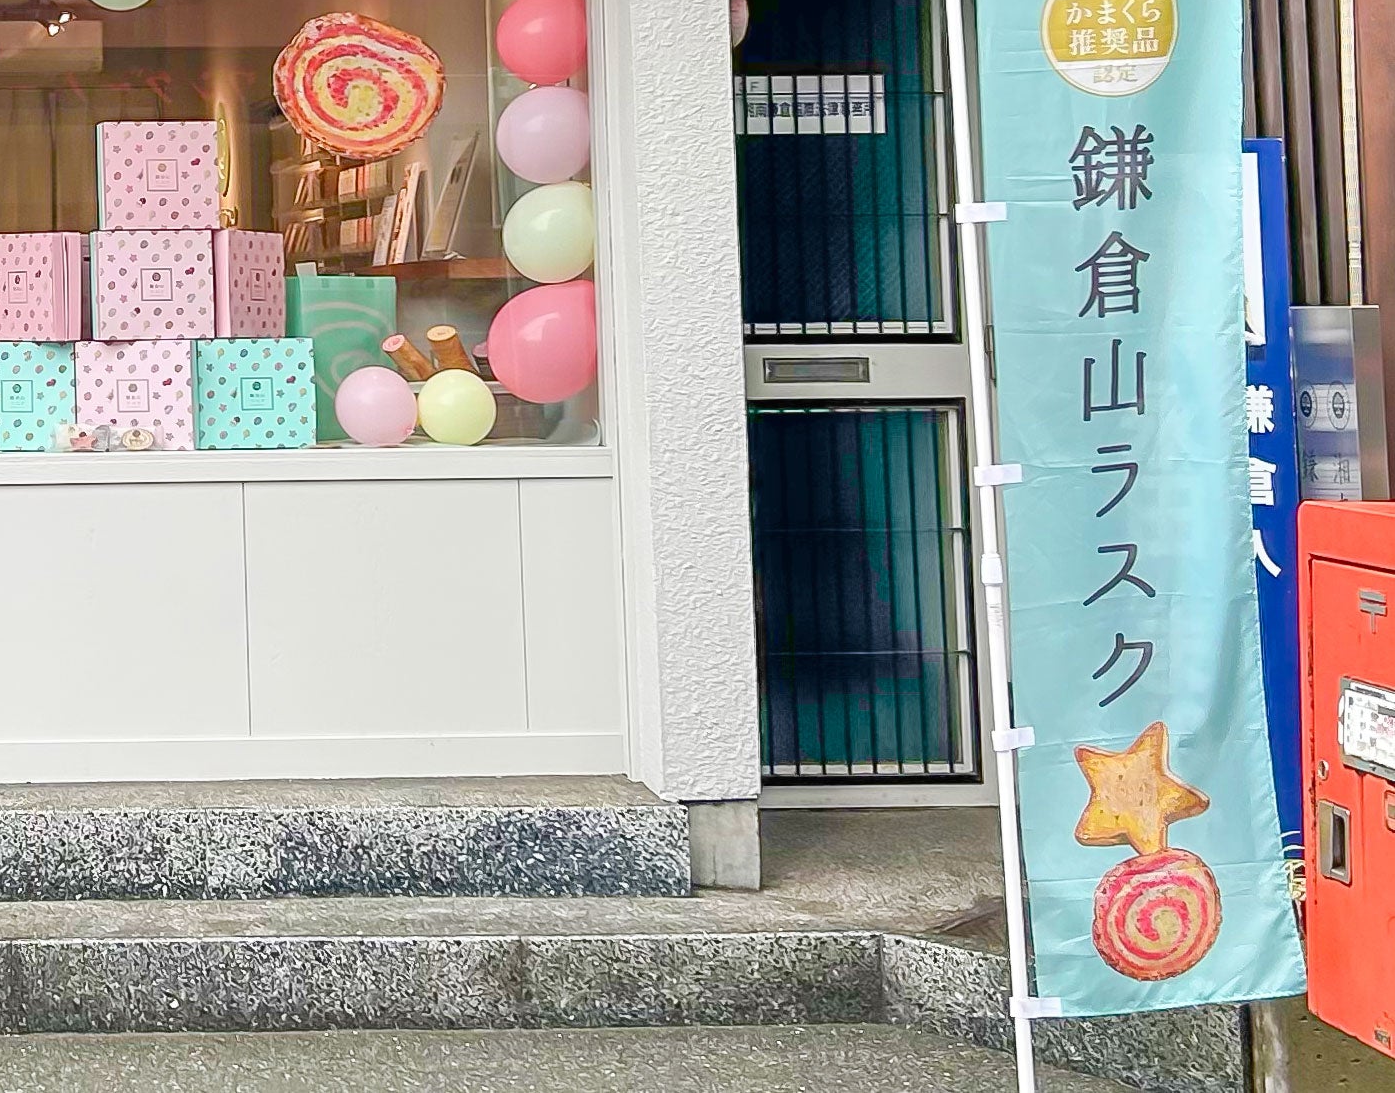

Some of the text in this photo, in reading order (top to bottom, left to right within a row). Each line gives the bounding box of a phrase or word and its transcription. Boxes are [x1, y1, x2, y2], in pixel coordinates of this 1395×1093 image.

[1068, 26, 1159, 56] 推奨品
[1093, 63, 1138, 83] 認定
[1068, 124, 1155, 708] 鎌倉山ラスク
